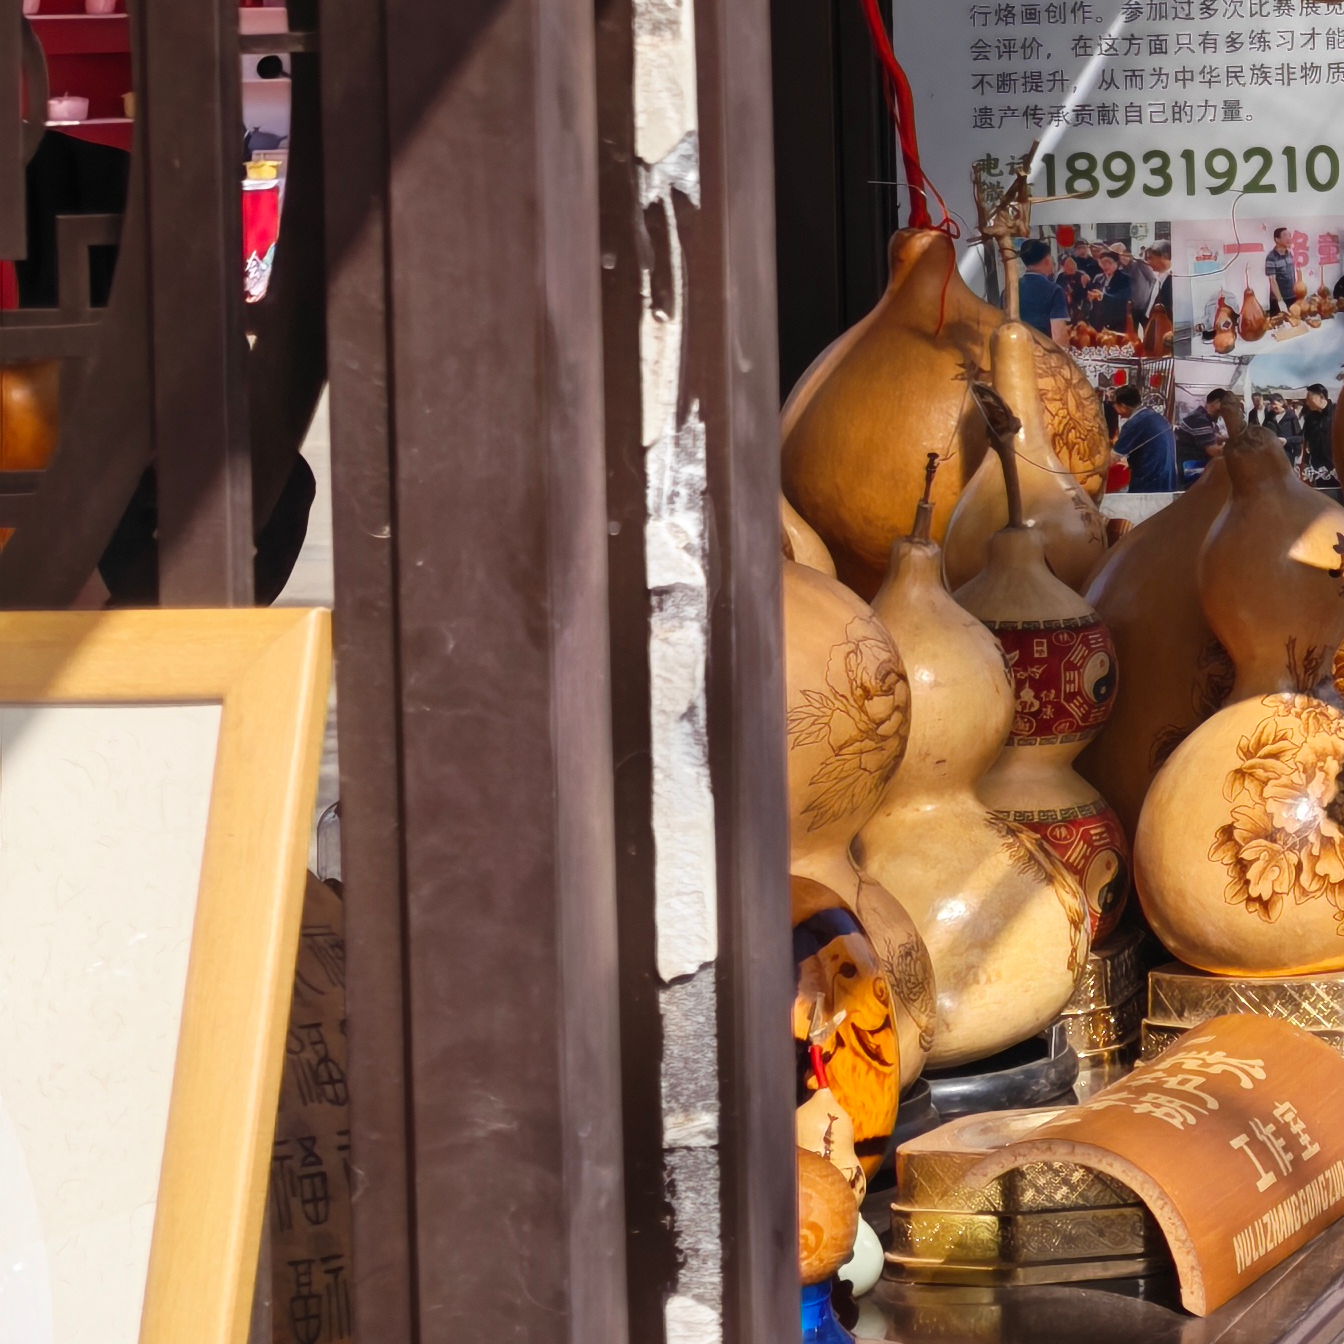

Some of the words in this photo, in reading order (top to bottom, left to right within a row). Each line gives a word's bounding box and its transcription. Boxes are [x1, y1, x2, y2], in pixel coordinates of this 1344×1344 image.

[971, 99, 1255, 130] 遗产传承贡献自己的力量。
[1229, 1102, 1321, 1193] 工作室
